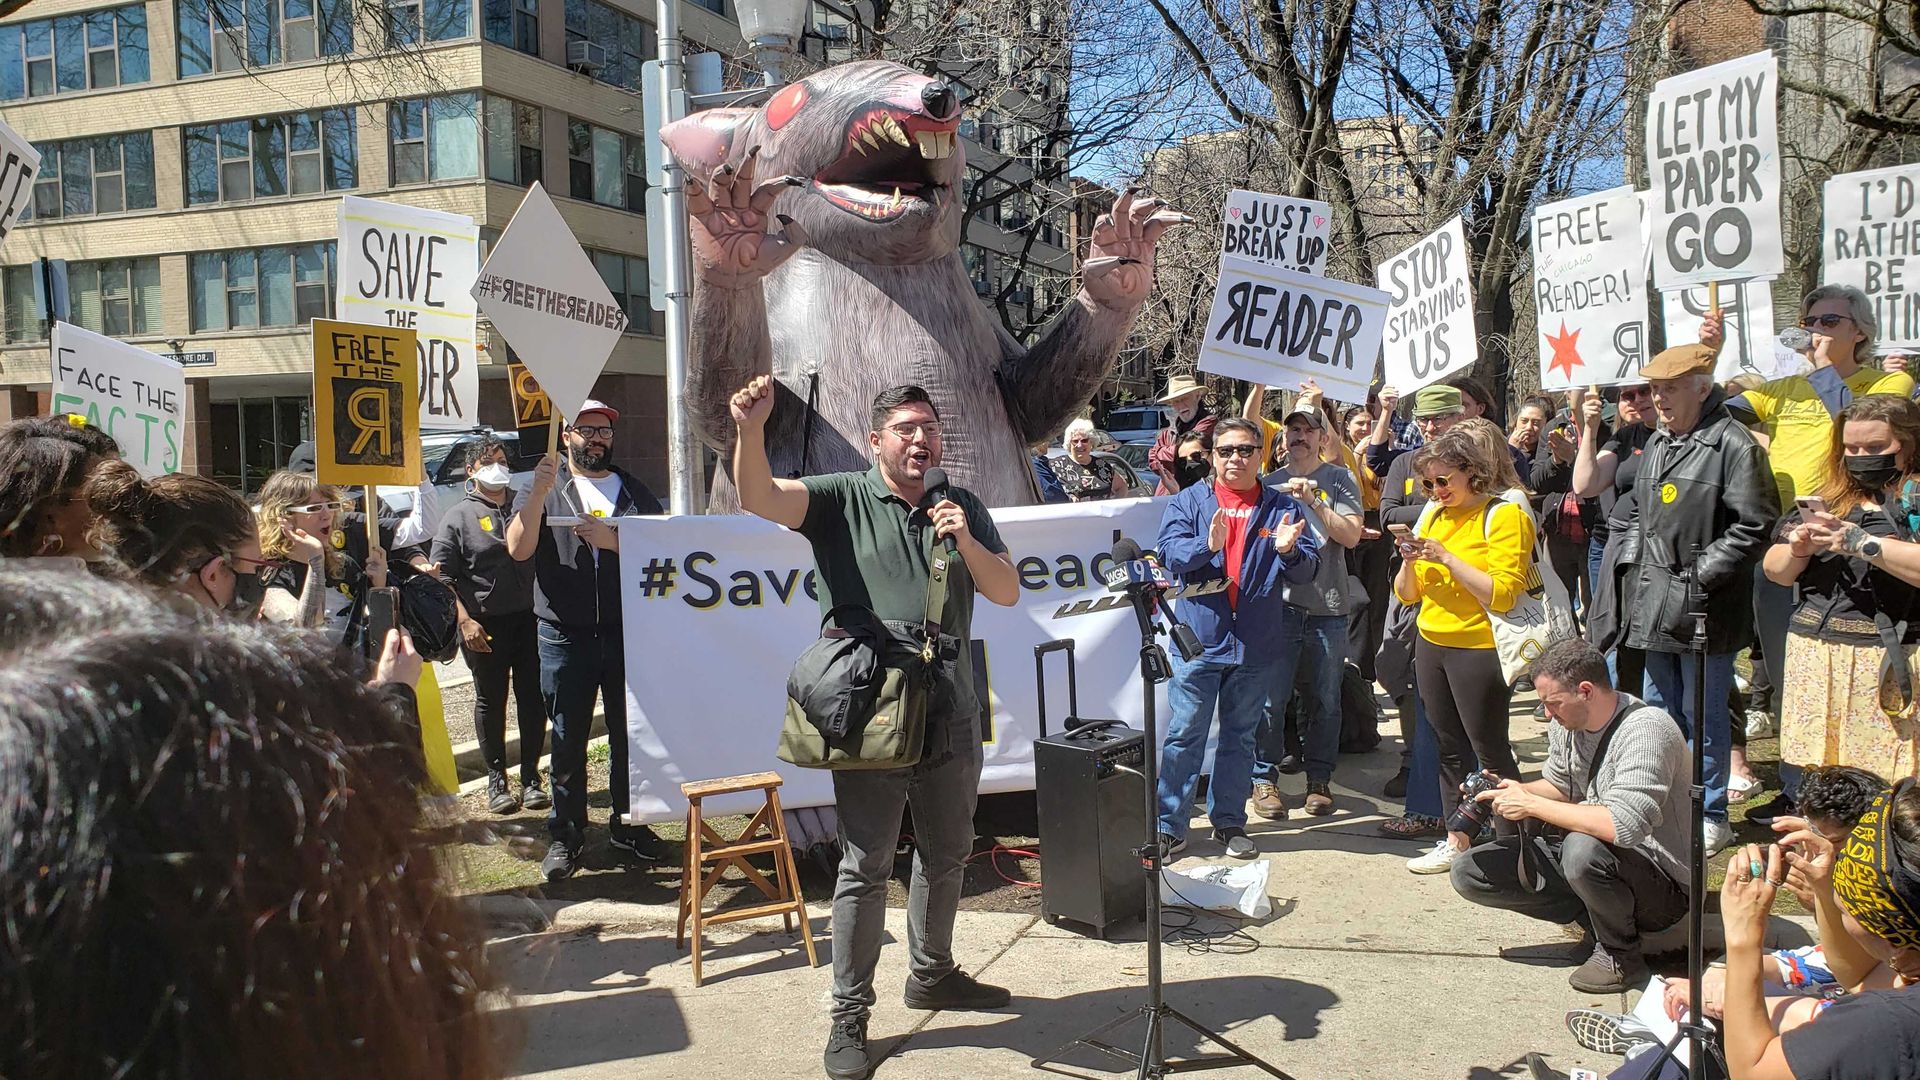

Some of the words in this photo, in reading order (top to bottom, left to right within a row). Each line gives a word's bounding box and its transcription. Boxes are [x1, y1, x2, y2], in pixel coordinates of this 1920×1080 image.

[1657, 88, 1712, 159] LET
[1718, 71, 1765, 144] MY
[1664, 144, 1763, 214] PAPER
[1860, 176, 1914, 221] I'D
[1243, 200, 1311, 234] JUST
[1538, 202, 1613, 252] FREE
[1666, 207, 1752, 273] GO
[1225, 224, 1288, 262] BREAK
[1296, 235, 1325, 265] UP
[1536, 254, 1554, 277] THE
[1553, 253, 1593, 278] CHICAGO
[359, 228, 447, 308] SAVE
[1390, 231, 1452, 308] STOP
[1865, 259, 1905, 295] BE
[1389, 277, 1466, 343] STARVING
[1537, 269, 1631, 315] READER!
[385, 309, 418, 328] THE
[332, 332, 401, 367] FREE
[333, 363, 394, 381] THE
[1409, 322, 1451, 379] US
[58, 347, 122, 398] FACE
[133, 381, 176, 414] THE
[1105, 566, 1128, 584] WGN
[1133, 560, 1145, 583] 9
